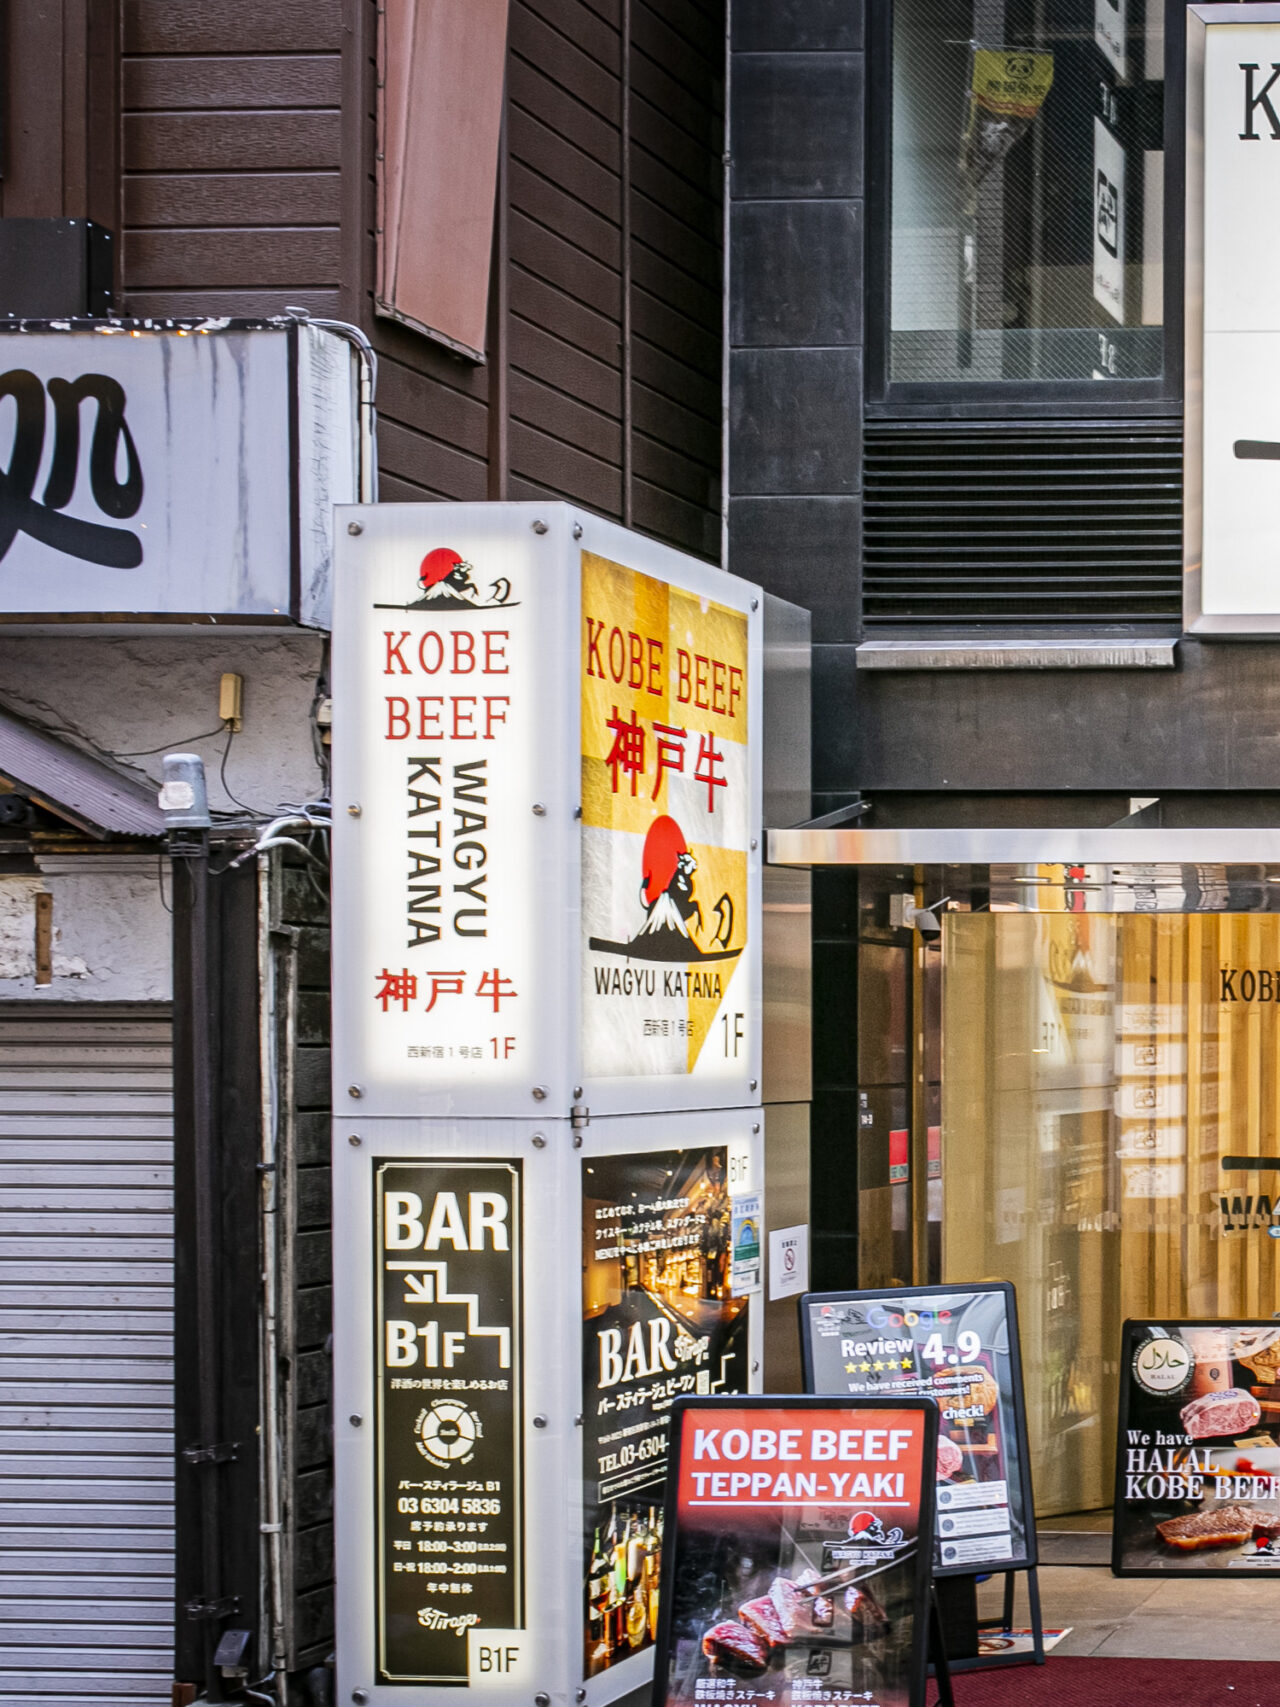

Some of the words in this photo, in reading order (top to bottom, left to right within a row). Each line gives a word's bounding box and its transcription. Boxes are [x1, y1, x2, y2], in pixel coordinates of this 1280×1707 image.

[384, 631, 510, 674] KOBE
[586, 617, 664, 697] KOBE
[676, 647, 743, 718] BEEF
[385, 696, 511, 740] BEEF
[605, 705, 729, 814] 神戸牛
[407, 756, 442, 948] KATANA
[452, 759, 488, 938] WAGYU
[375, 968, 518, 1013] 神戸牛
[594, 966, 656, 998] WAGYU
[663, 968, 723, 1000] KATANA
[490, 1037, 516, 1059] 1F
[722, 1012, 745, 1058] 1F
[730, 1156, 749, 1183] B1F
[384, 1191, 509, 1252] BAR
[866, 1305, 953, 1332] Google
[385, 1320, 466, 1368] B1F
[597, 1317, 678, 1389] BAR
[840, 1336, 915, 1359] Review
[922, 1330, 982, 1366] 4.9
[1142, 1347, 1185, 1370] حلال
[848, 1382, 866, 1394] We
[866, 1380, 890, 1392] have
[891, 1376, 933, 1391] received
[933, 1373, 985, 1386] comments
[942, 1405, 985, 1421] check!
[693, 1429, 803, 1461] KOBE
[811, 1429, 912, 1461] BEEF
[1127, 1430, 1150, 1445] We
[1155, 1430, 1194, 1446] have
[1126, 1449, 1220, 1474] HALAL
[486, 1481, 501, 1492] B1
[691, 1472, 904, 1498] TEPPAN-YAKI
[1124, 1475, 1204, 1500] KOBE
[397, 1497, 419, 1514] 03
[420, 1498, 460, 1515] 6304
[461, 1499, 501, 1515] 5836
[426, 1582, 474, 1594] 年中無休
[479, 1646, 520, 1673] B1F
